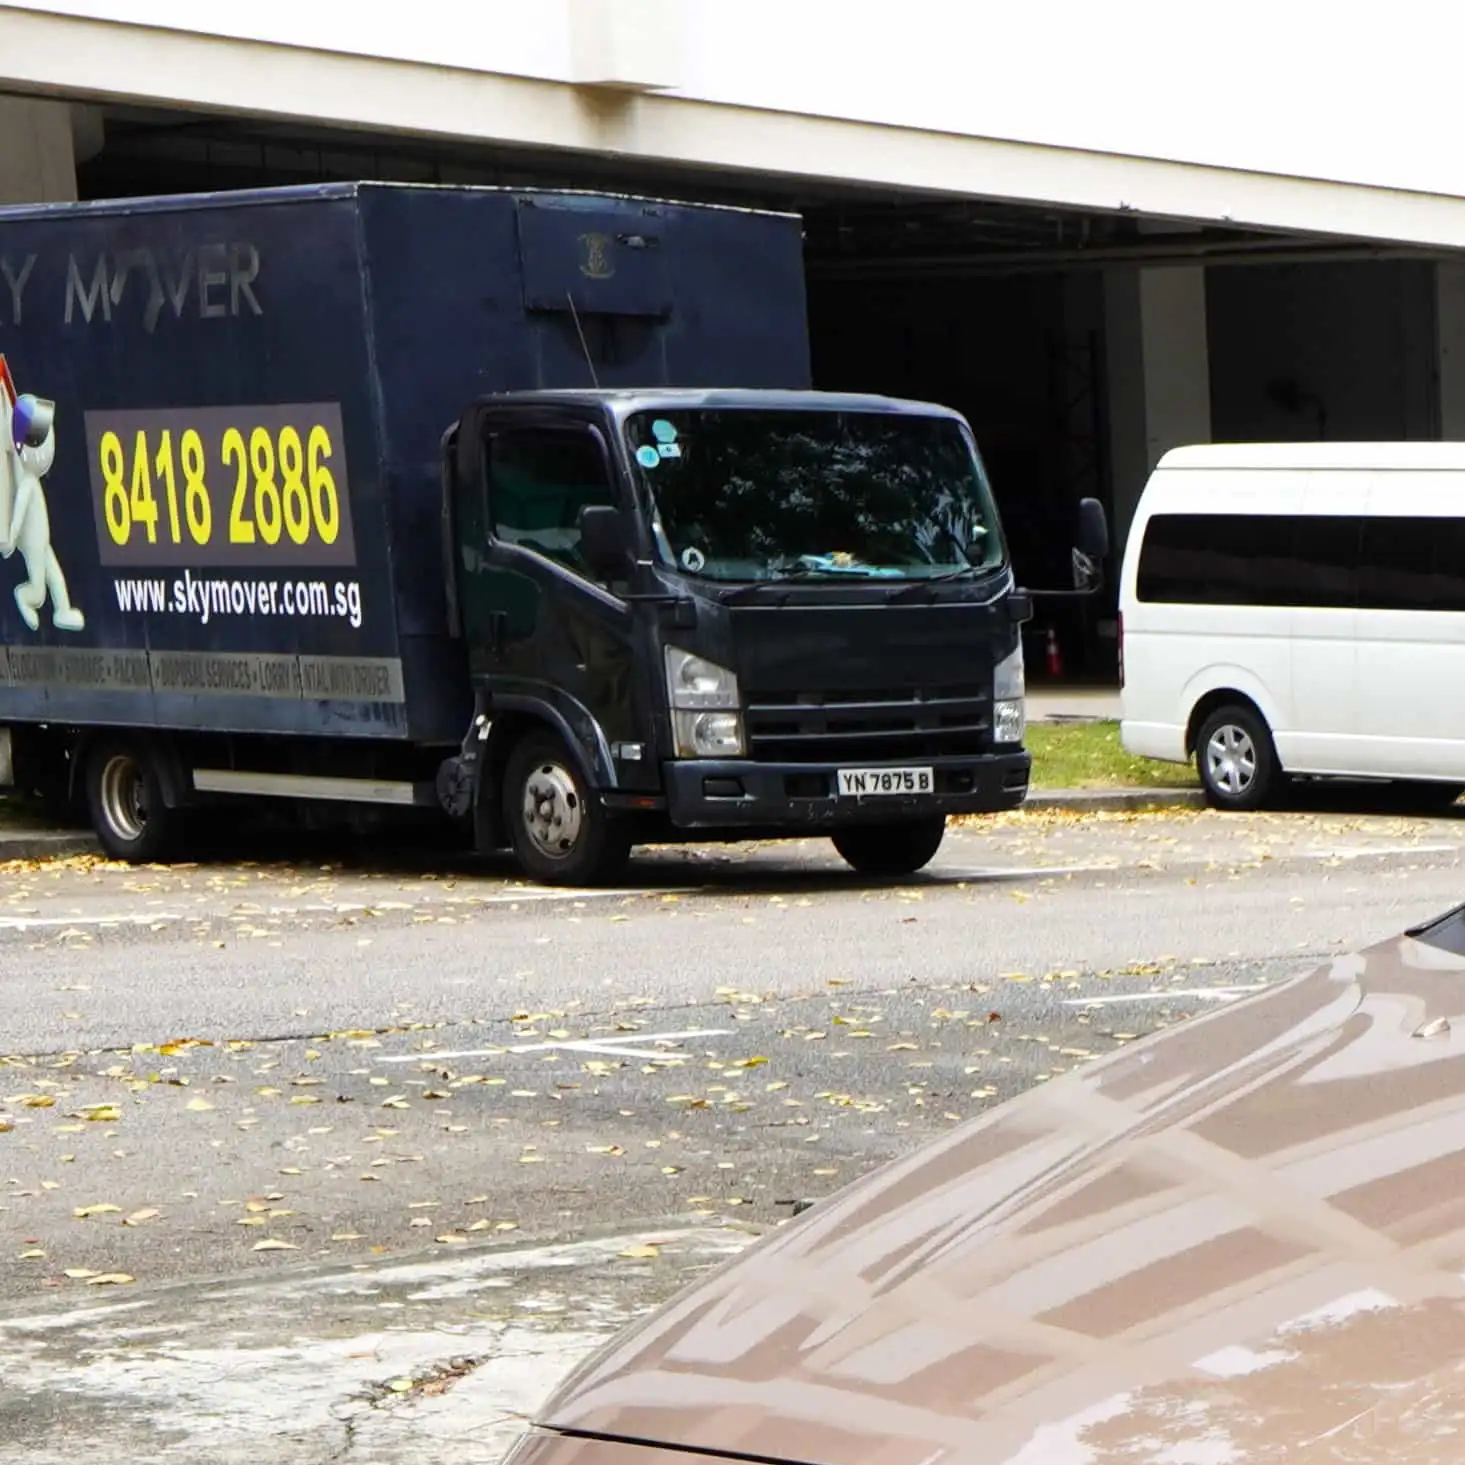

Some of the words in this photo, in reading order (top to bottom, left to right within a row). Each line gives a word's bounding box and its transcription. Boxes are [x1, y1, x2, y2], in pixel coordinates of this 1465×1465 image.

[0, 253, 38, 327] Y
[100, 428, 212, 546] 8418
[221, 424, 340, 546] 2886
[114, 568, 362, 629] www.skymover.com.sg
[843, 772, 866, 793] YN
[869, 771, 915, 791] 7875
[919, 772, 929, 790] B
